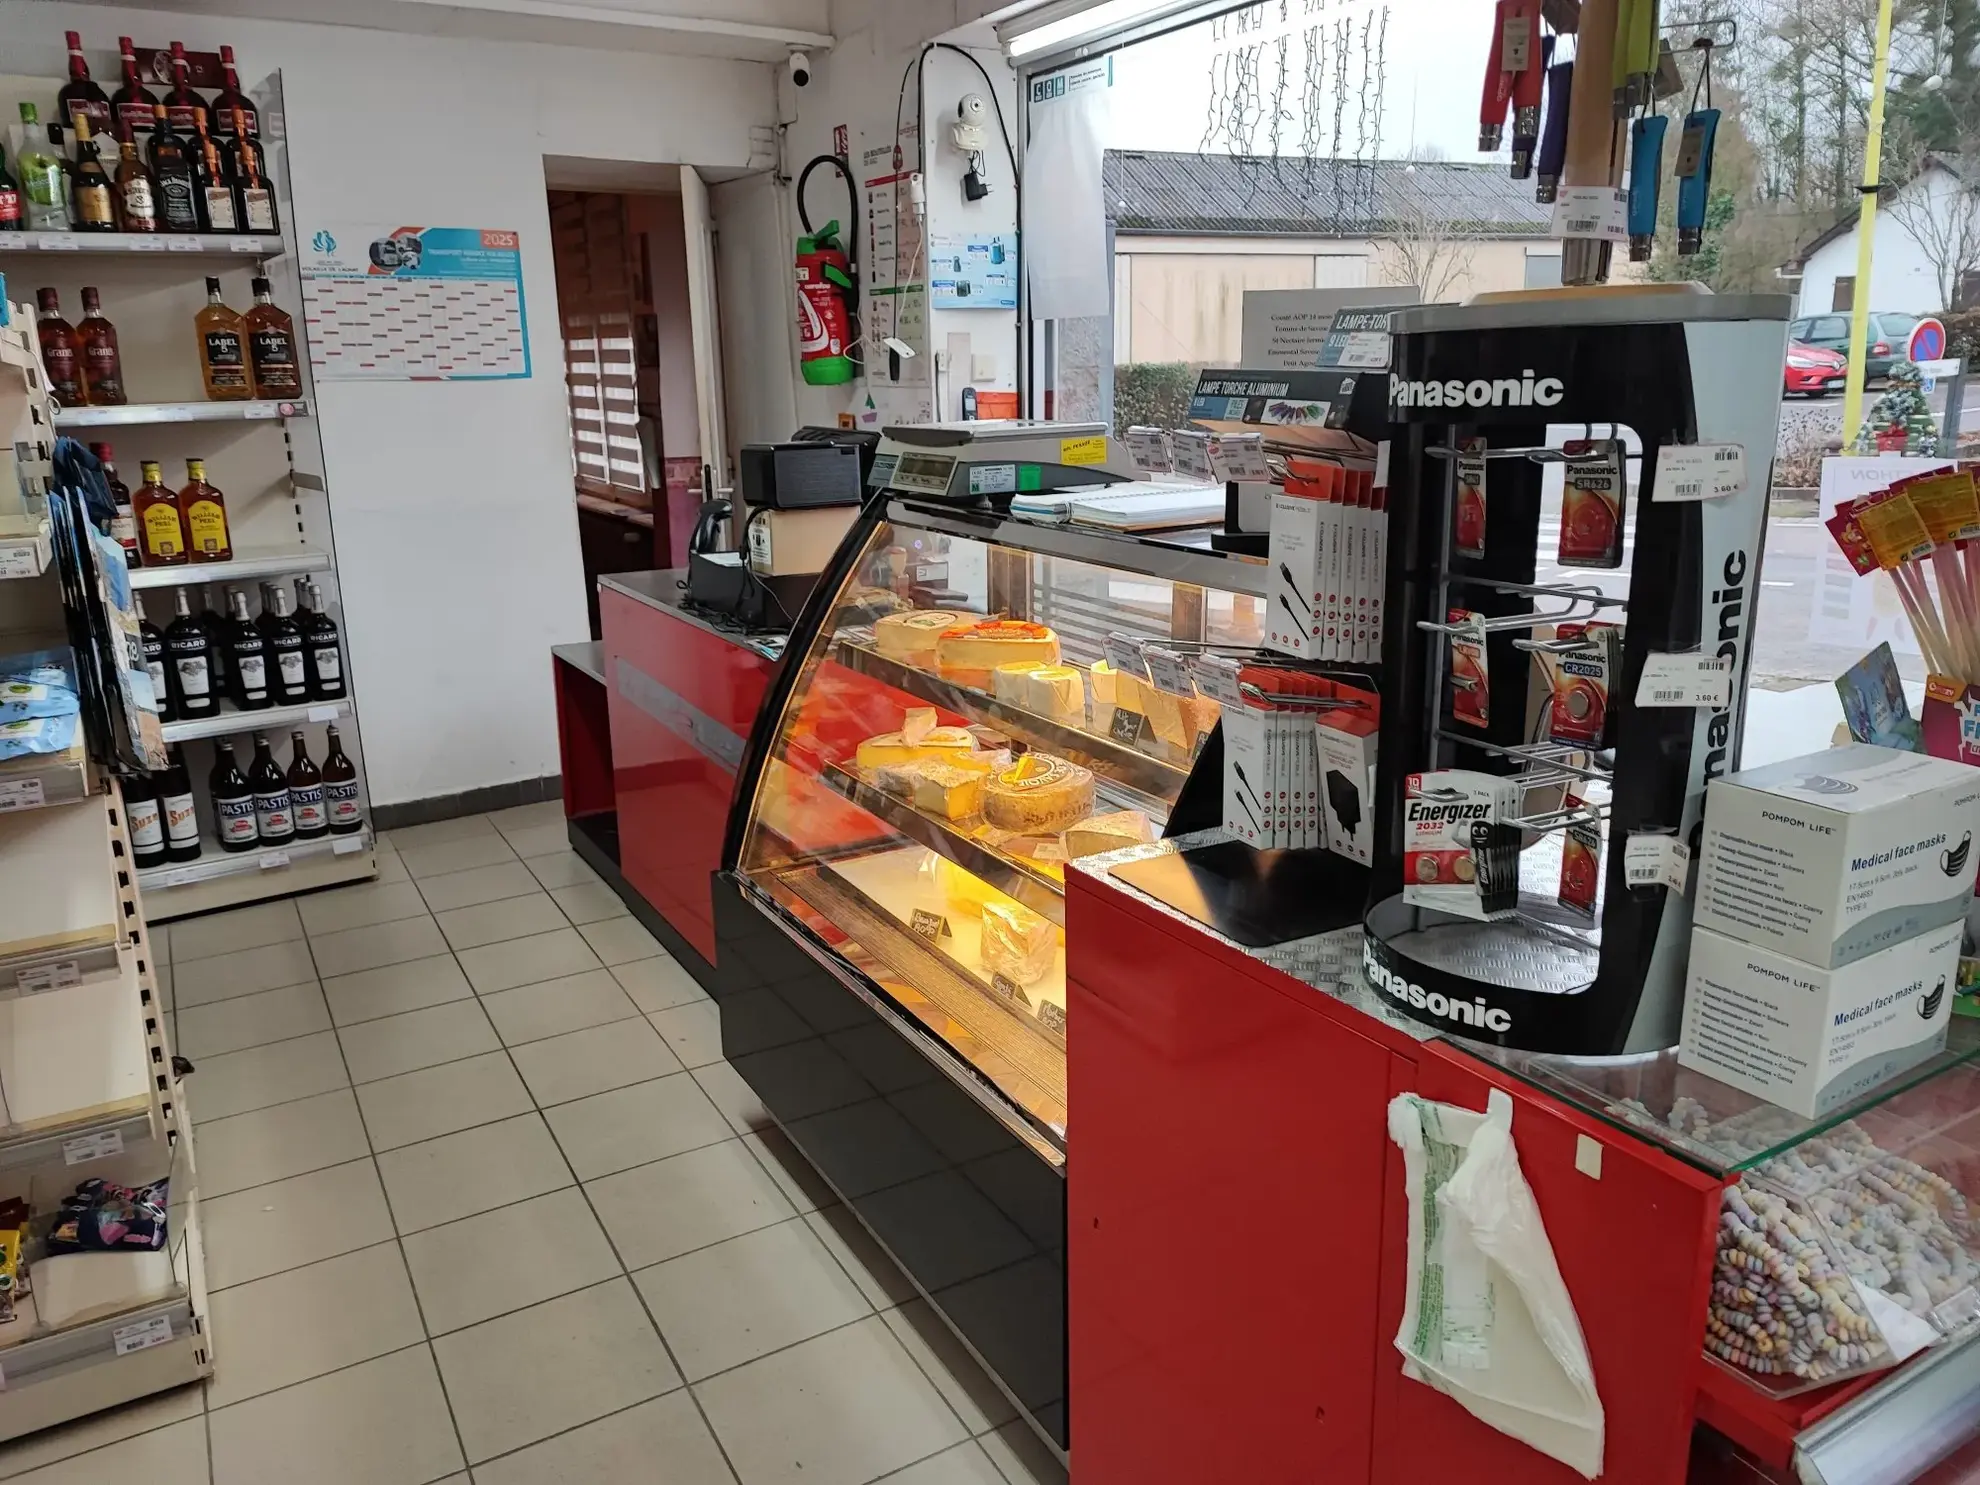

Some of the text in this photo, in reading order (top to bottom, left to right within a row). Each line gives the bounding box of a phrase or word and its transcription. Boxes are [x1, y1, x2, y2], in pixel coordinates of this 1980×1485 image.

[483, 233, 514, 246] 2025
[208, 338, 238, 346] LABEL
[259, 337, 287, 345] LABEL
[1197, 381, 1290, 397] LAMPE TORCHE ALUMINIUM
[1388, 368, 1564, 408] Panasonic
[1567, 464, 1618, 475] Panasonic
[1576, 478, 1611, 490] SR626
[274, 637, 302, 646] RICARD
[310, 632, 338, 642] RICARD
[171, 639, 206, 650] RICARD
[234, 641, 264, 650] RICARD
[1558, 651, 1607, 663] Panasonic
[1565, 661, 1602, 677] CR2025
[1408, 777, 1420, 786] 10
[291, 789, 322, 803] PASTIS
[327, 783, 358, 797] PASTIS
[221, 801, 254, 815] PASTIS
[257, 794, 290, 809] PASTIS
[1408, 802, 1492, 824] Energizer
[1762, 811, 1805, 829] POMPOM
[1416, 822, 1444, 830] 2032
[1851, 832, 1947, 872] Medical face masks
[1747, 963, 1790, 983] POMPOM
[1363, 938, 1512, 1033] Panasonic
[1834, 979, 1924, 1027] Medical face masks
